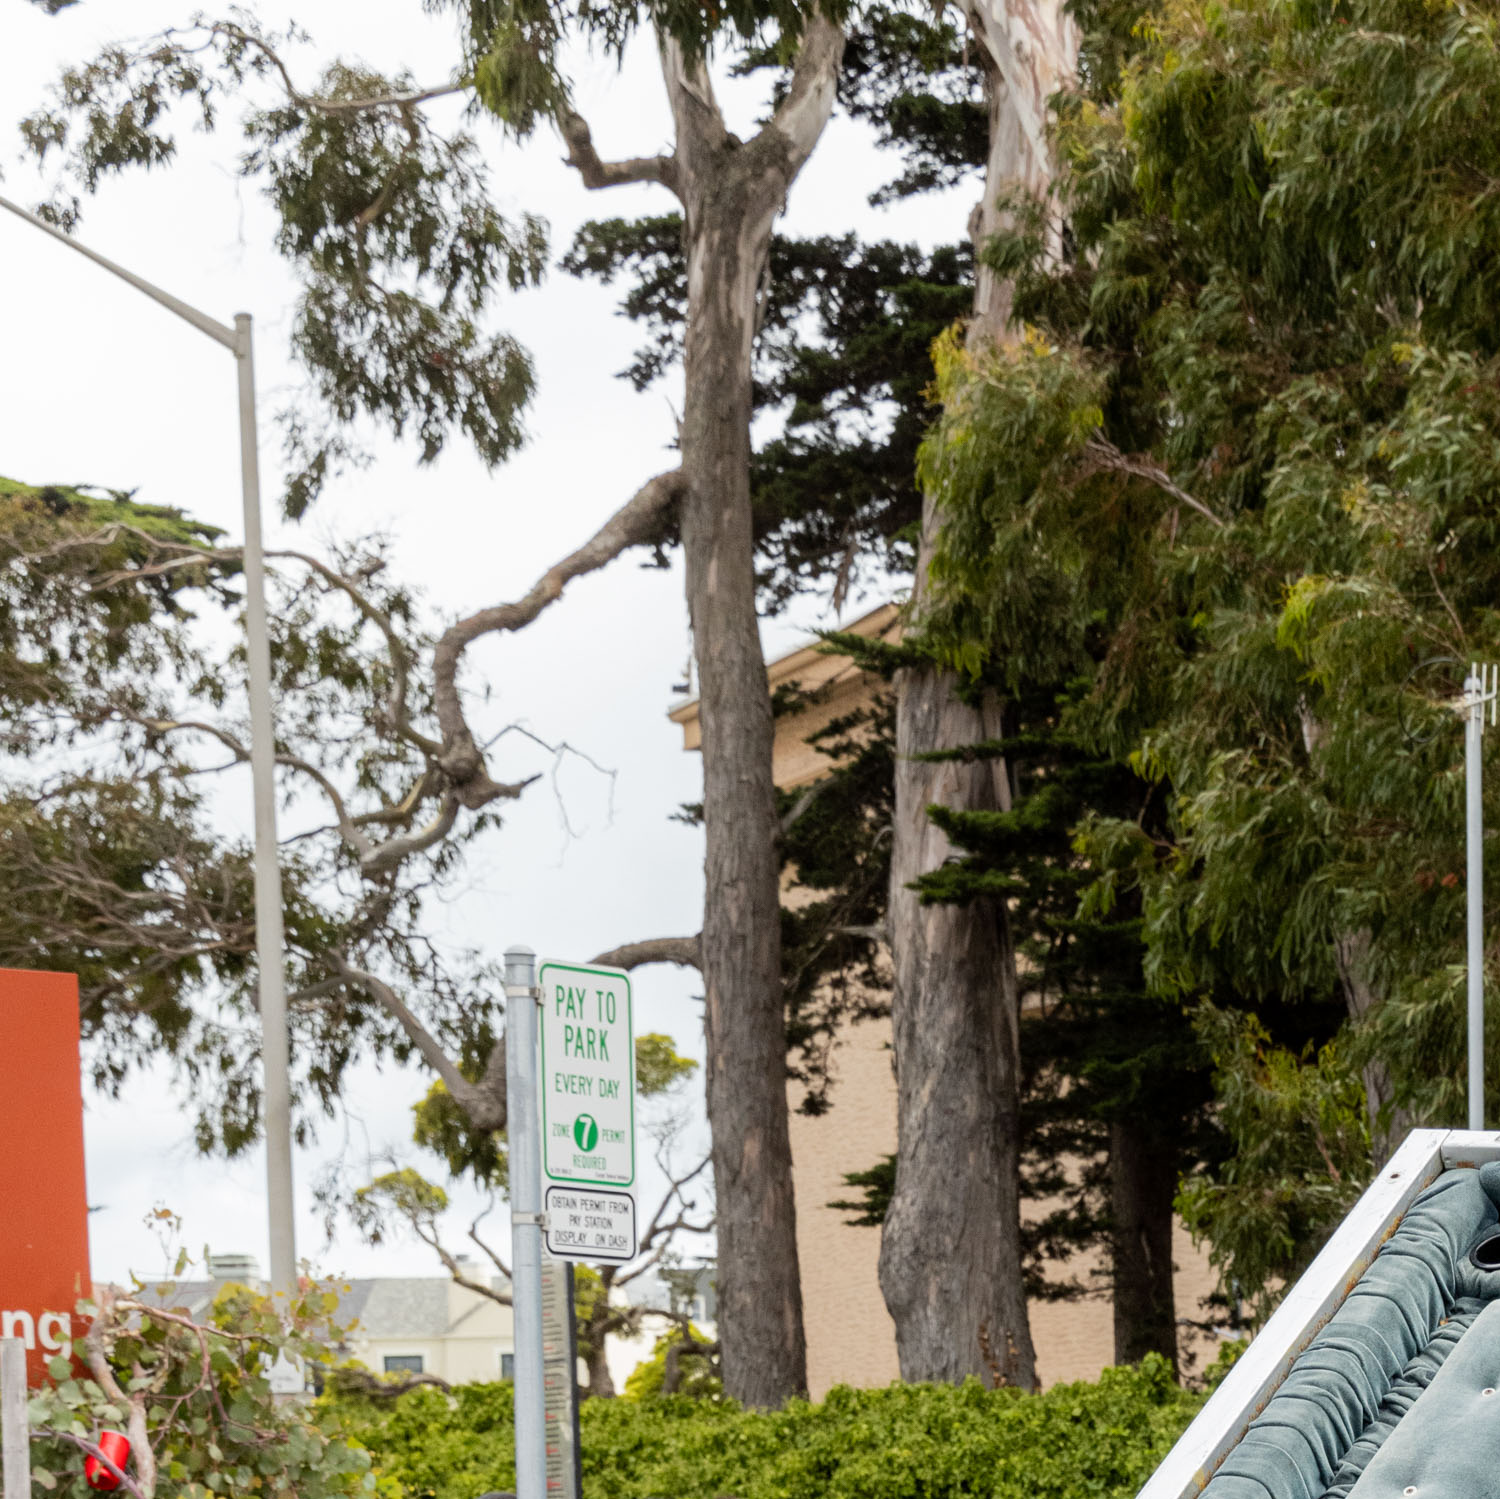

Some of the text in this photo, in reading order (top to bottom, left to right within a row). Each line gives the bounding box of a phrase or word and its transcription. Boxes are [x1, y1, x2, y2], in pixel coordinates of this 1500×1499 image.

[556, 985, 616, 1024] PAY TO
[564, 1025, 609, 1062] PARK
[555, 1073, 620, 1100] EVERY DAY
[552, 1116, 625, 1150] ZONE 7 PERMIT
[573, 1154, 607, 1171] REQUIRED
[552, 1196, 629, 1214] OBTAIN PERMIT FROM
[569, 1214, 613, 1230] PAY STATION
[555, 1230, 628, 1248] DISPLAY ON DASH
